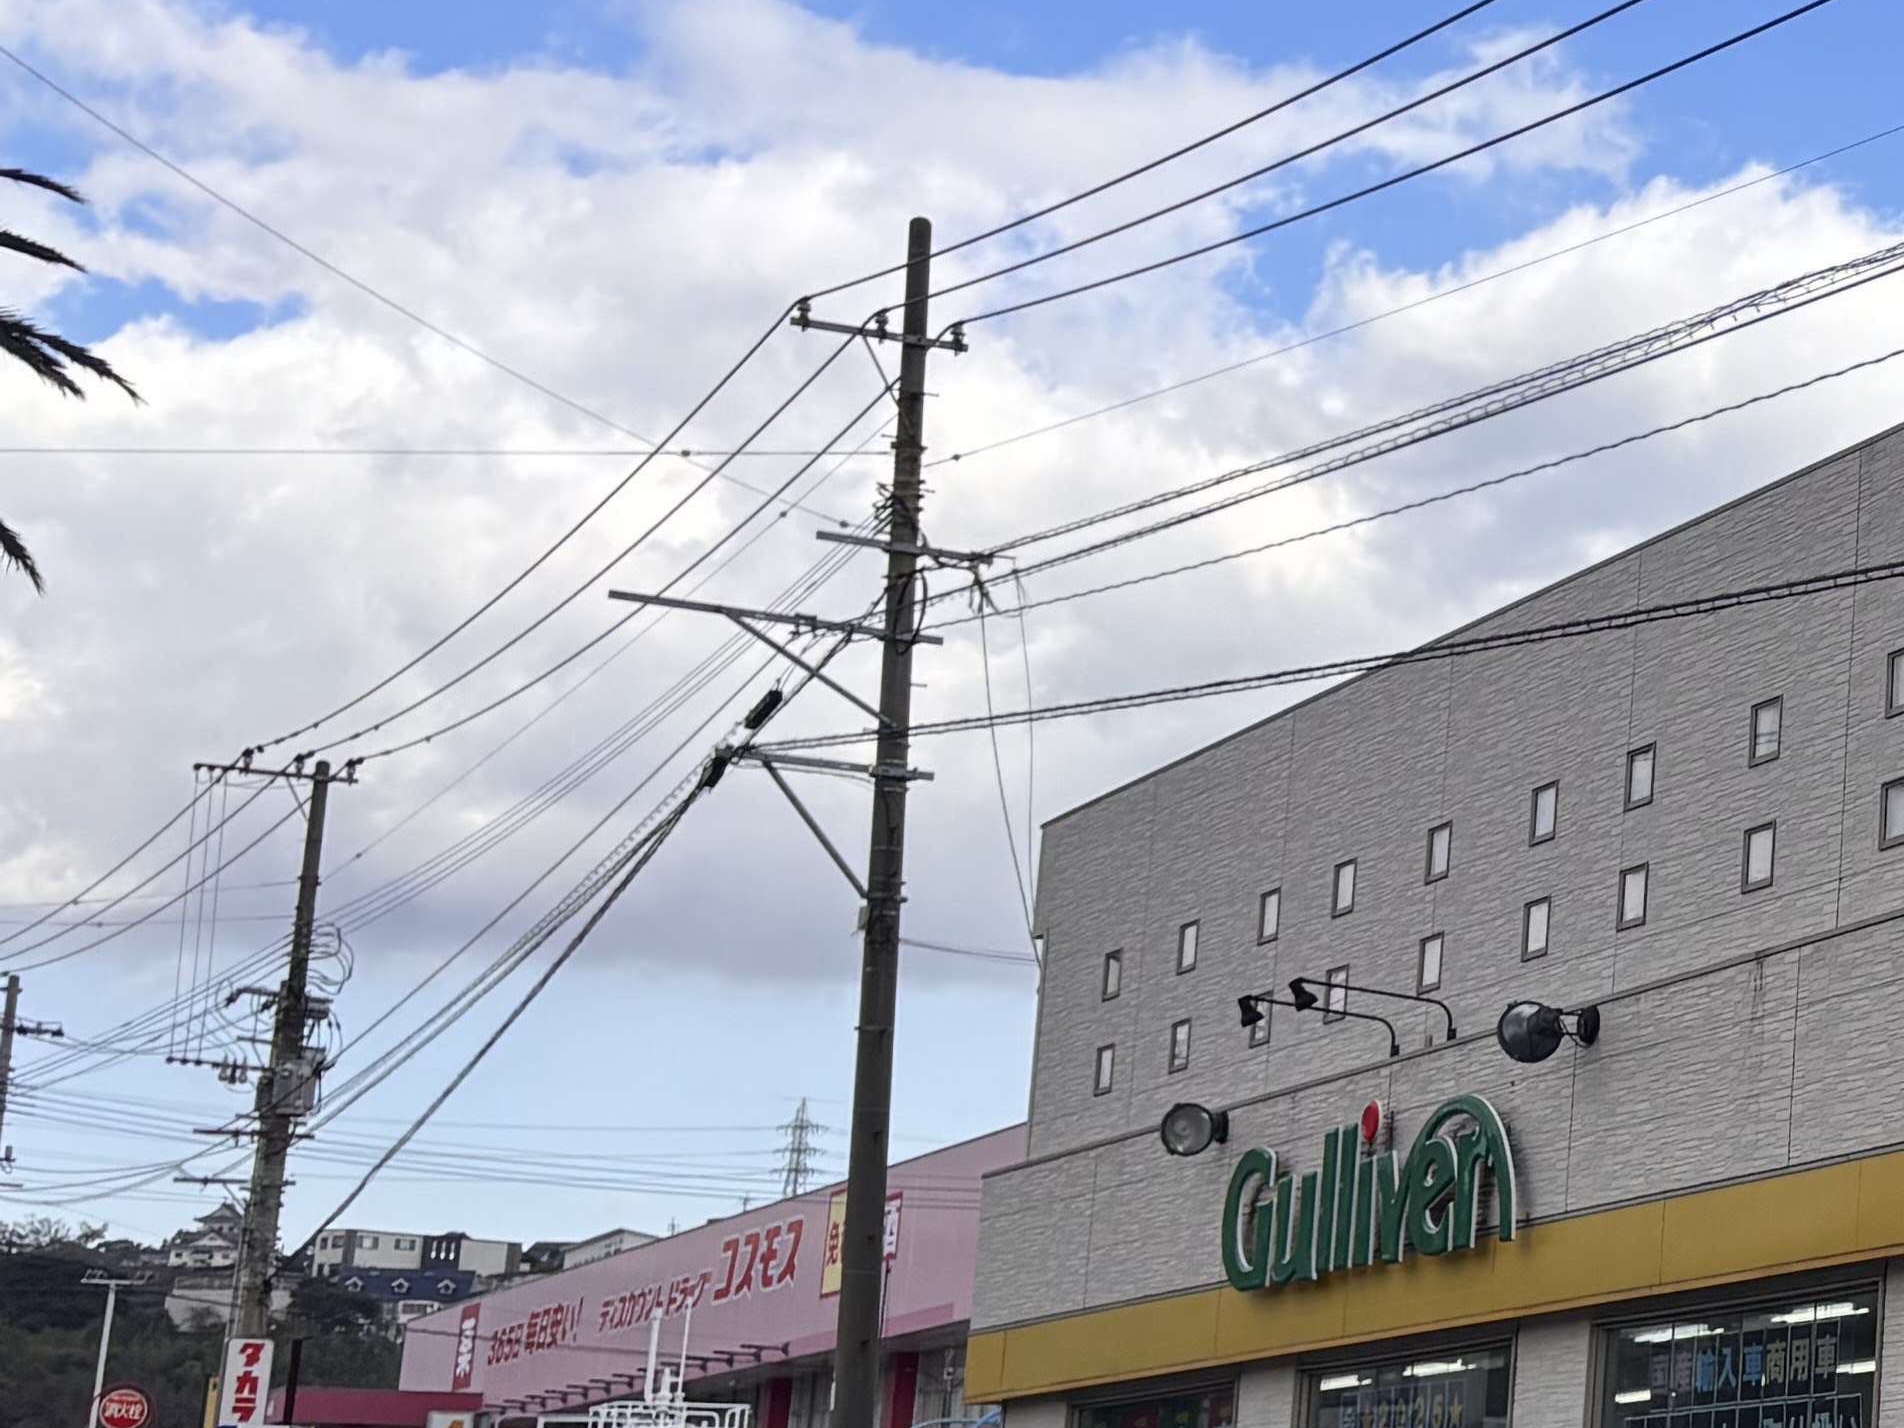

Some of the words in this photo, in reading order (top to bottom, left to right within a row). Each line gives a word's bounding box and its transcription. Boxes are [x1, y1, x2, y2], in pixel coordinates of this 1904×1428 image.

[1222, 1093, 1516, 1292] Gulliver
[713, 1218, 804, 1301] コスモス
[232, 1343, 265, 1423] タカラ
